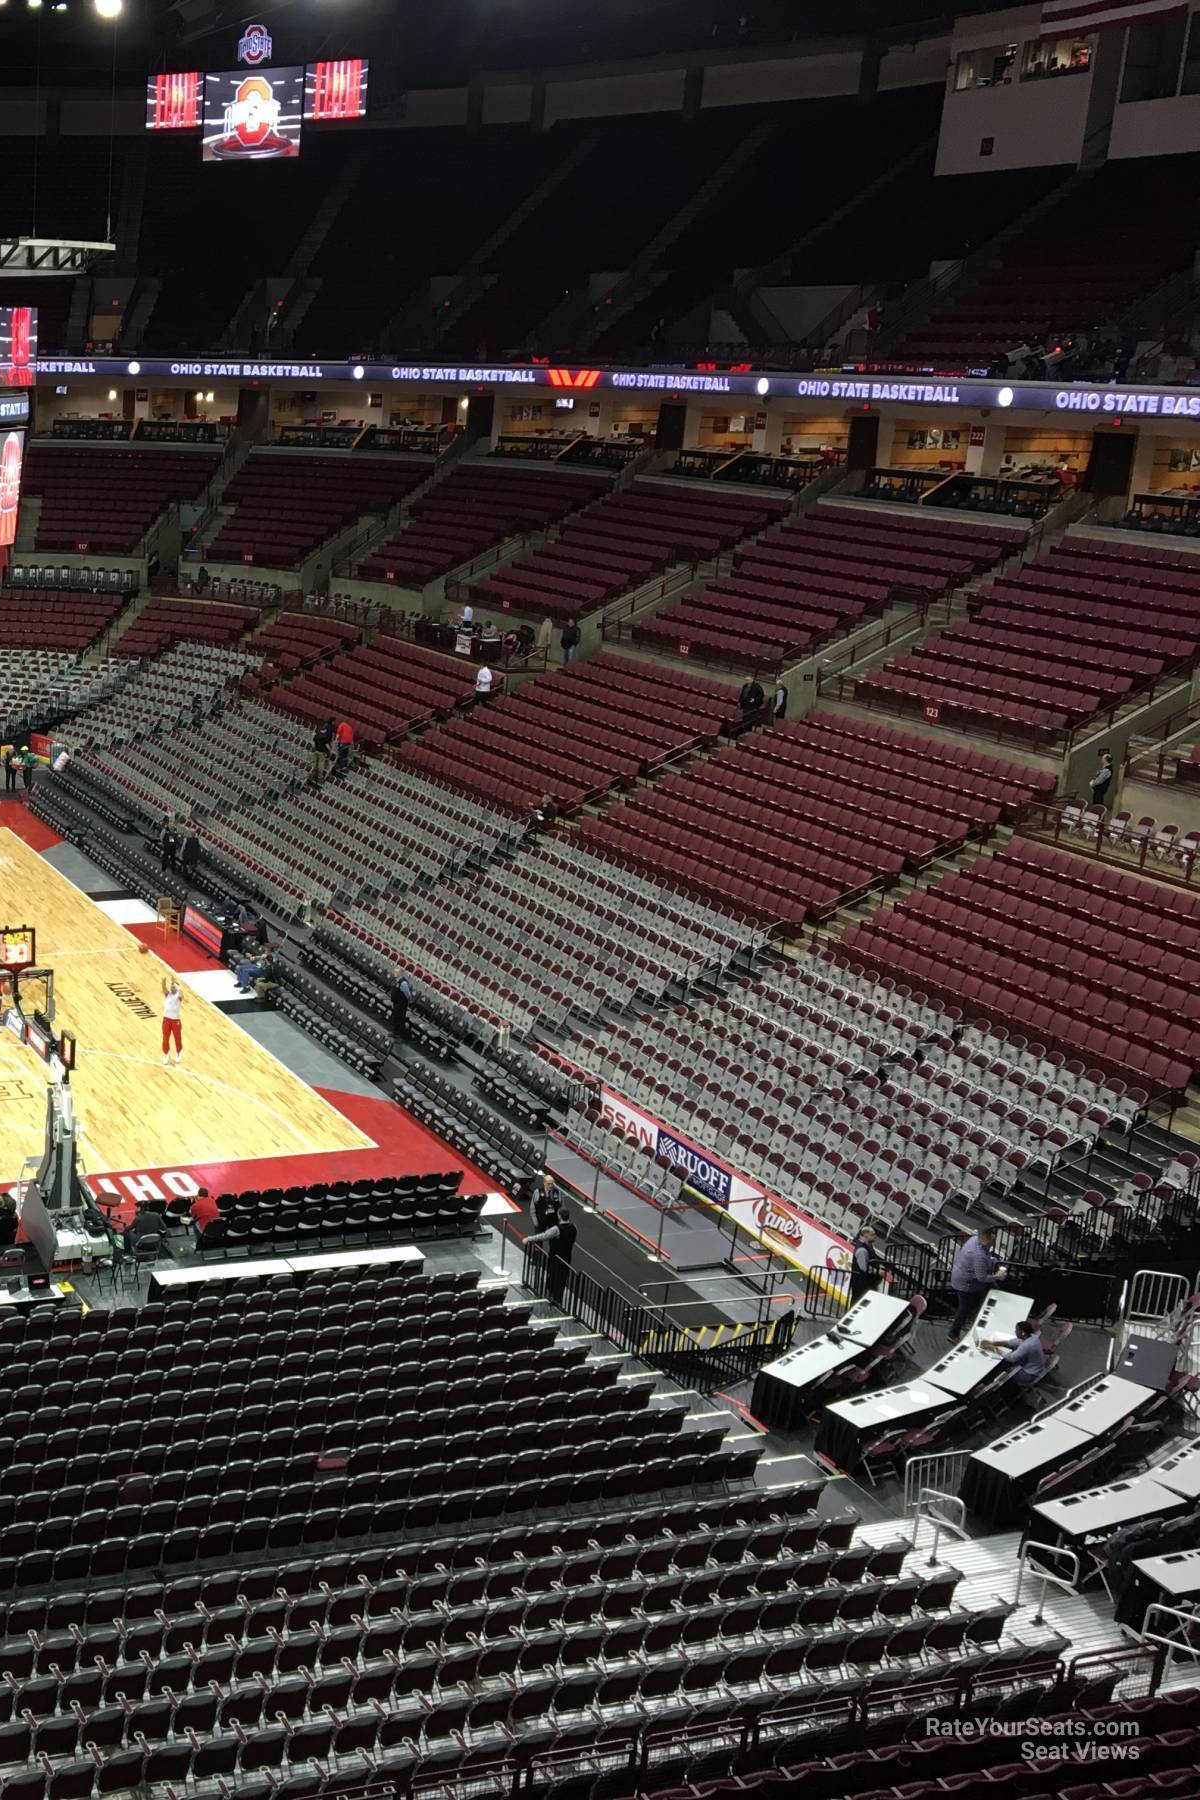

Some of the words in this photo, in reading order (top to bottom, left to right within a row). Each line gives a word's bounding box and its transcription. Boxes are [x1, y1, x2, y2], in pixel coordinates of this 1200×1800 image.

[171, 364, 202, 375] OHIO
[204, 364, 240, 376] STATE
[243, 365, 323, 377] BASKETBALL
[392, 367, 421, 379] OHIO
[422, 368, 456, 380] STATE
[459, 369, 535, 382] BASKETBALL
[612, 373, 635, 387] OHIO
[636, 374, 665, 388] STATE
[667, 375, 730, 391] BASKETBALL
[799, 380, 828, 396] OHIO
[832, 382, 869, 398] STATE
[872, 384, 959, 402] BASKETBALL
[0, 402, 22, 416] STATE
[1055, 392, 1099, 411] OHIO
[1104, 394, 1157, 413] STATE
[972, 432, 984, 440] 222
[926, 707, 938, 718] 123
[104, 981, 137, 1000] CITY
[123, 992, 158, 1021] VALUE
[602, 1103, 654, 1148] SSAN
[675, 1144, 729, 1194] RUOFF
[90, 1171, 201, 1205] OHI
[752, 1198, 803, 1240] Cane's
